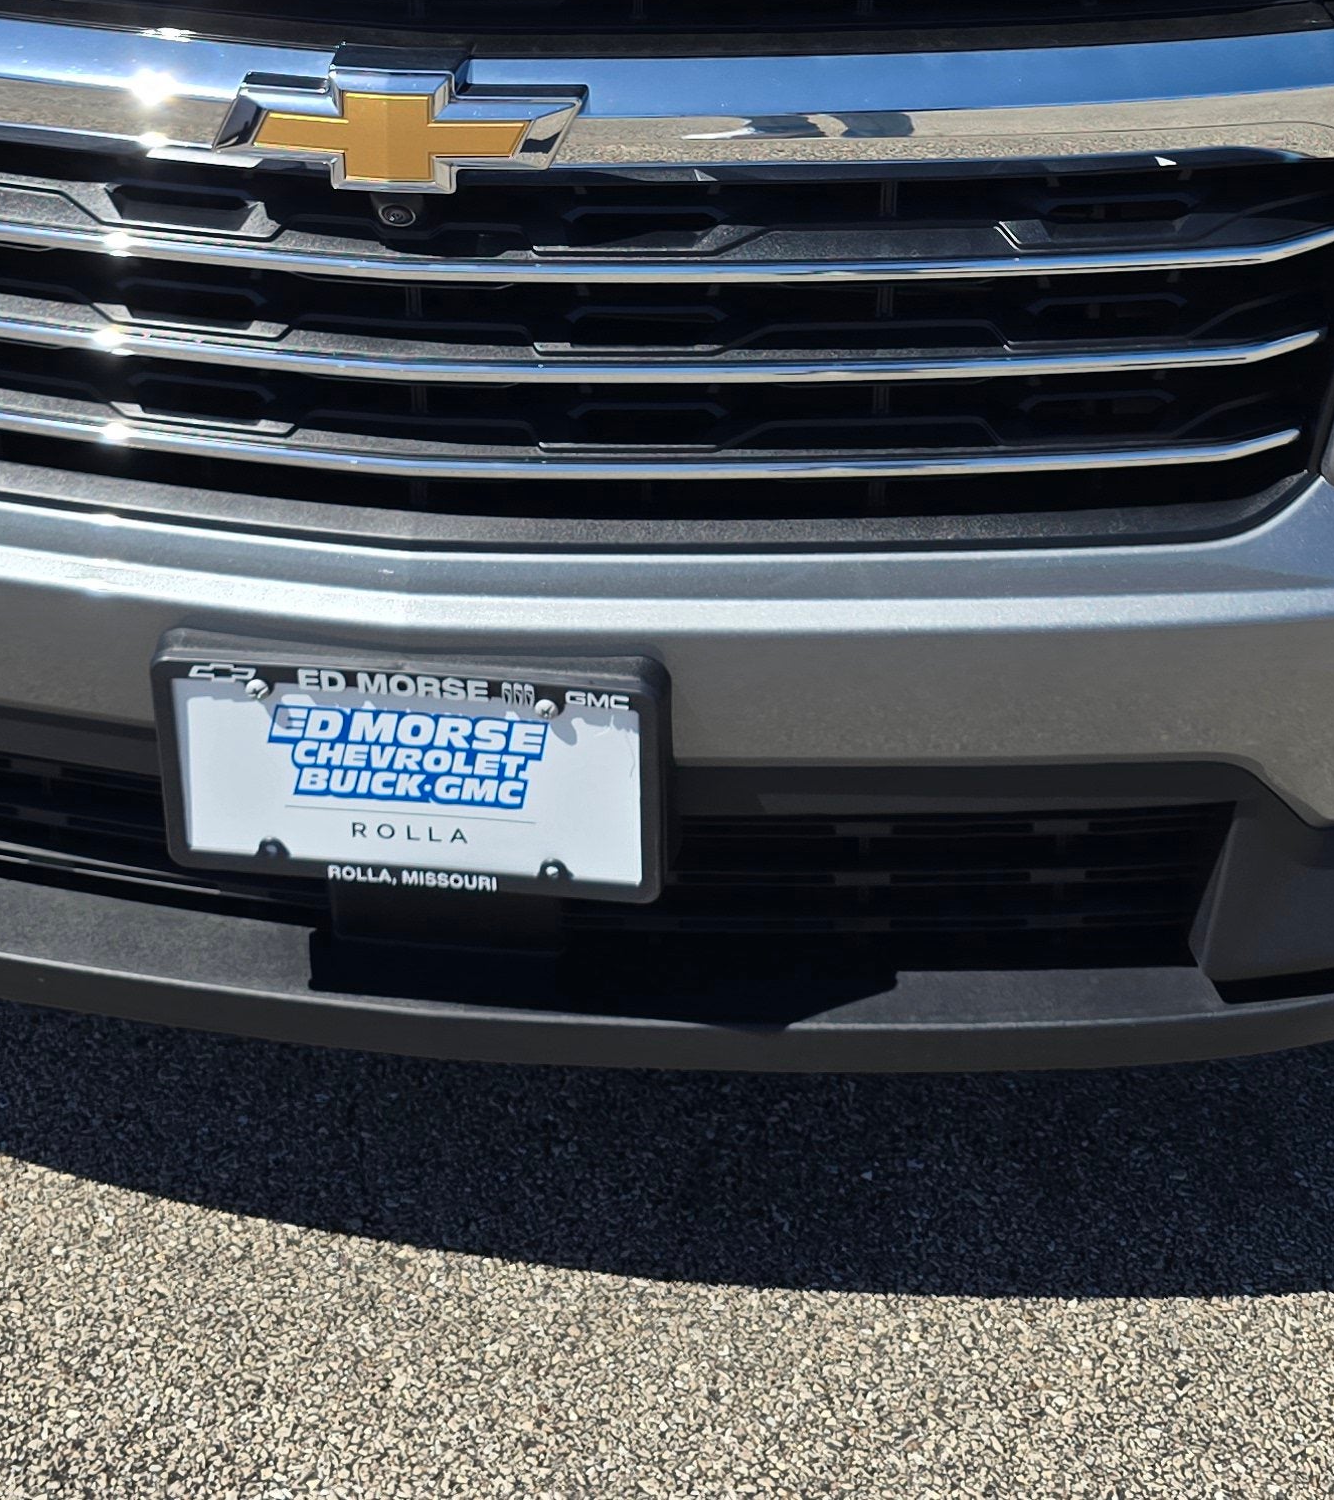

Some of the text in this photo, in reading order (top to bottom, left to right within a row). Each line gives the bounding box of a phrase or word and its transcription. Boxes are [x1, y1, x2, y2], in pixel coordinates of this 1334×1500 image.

[297, 668, 630, 711] ED MORSE GMC
[270, 707, 547, 754] ED MORSE
[293, 740, 526, 779] CHEVROLET
[351, 822, 469, 844] ROLLA
[327, 864, 498, 892] ROLLA, MISSOURI
